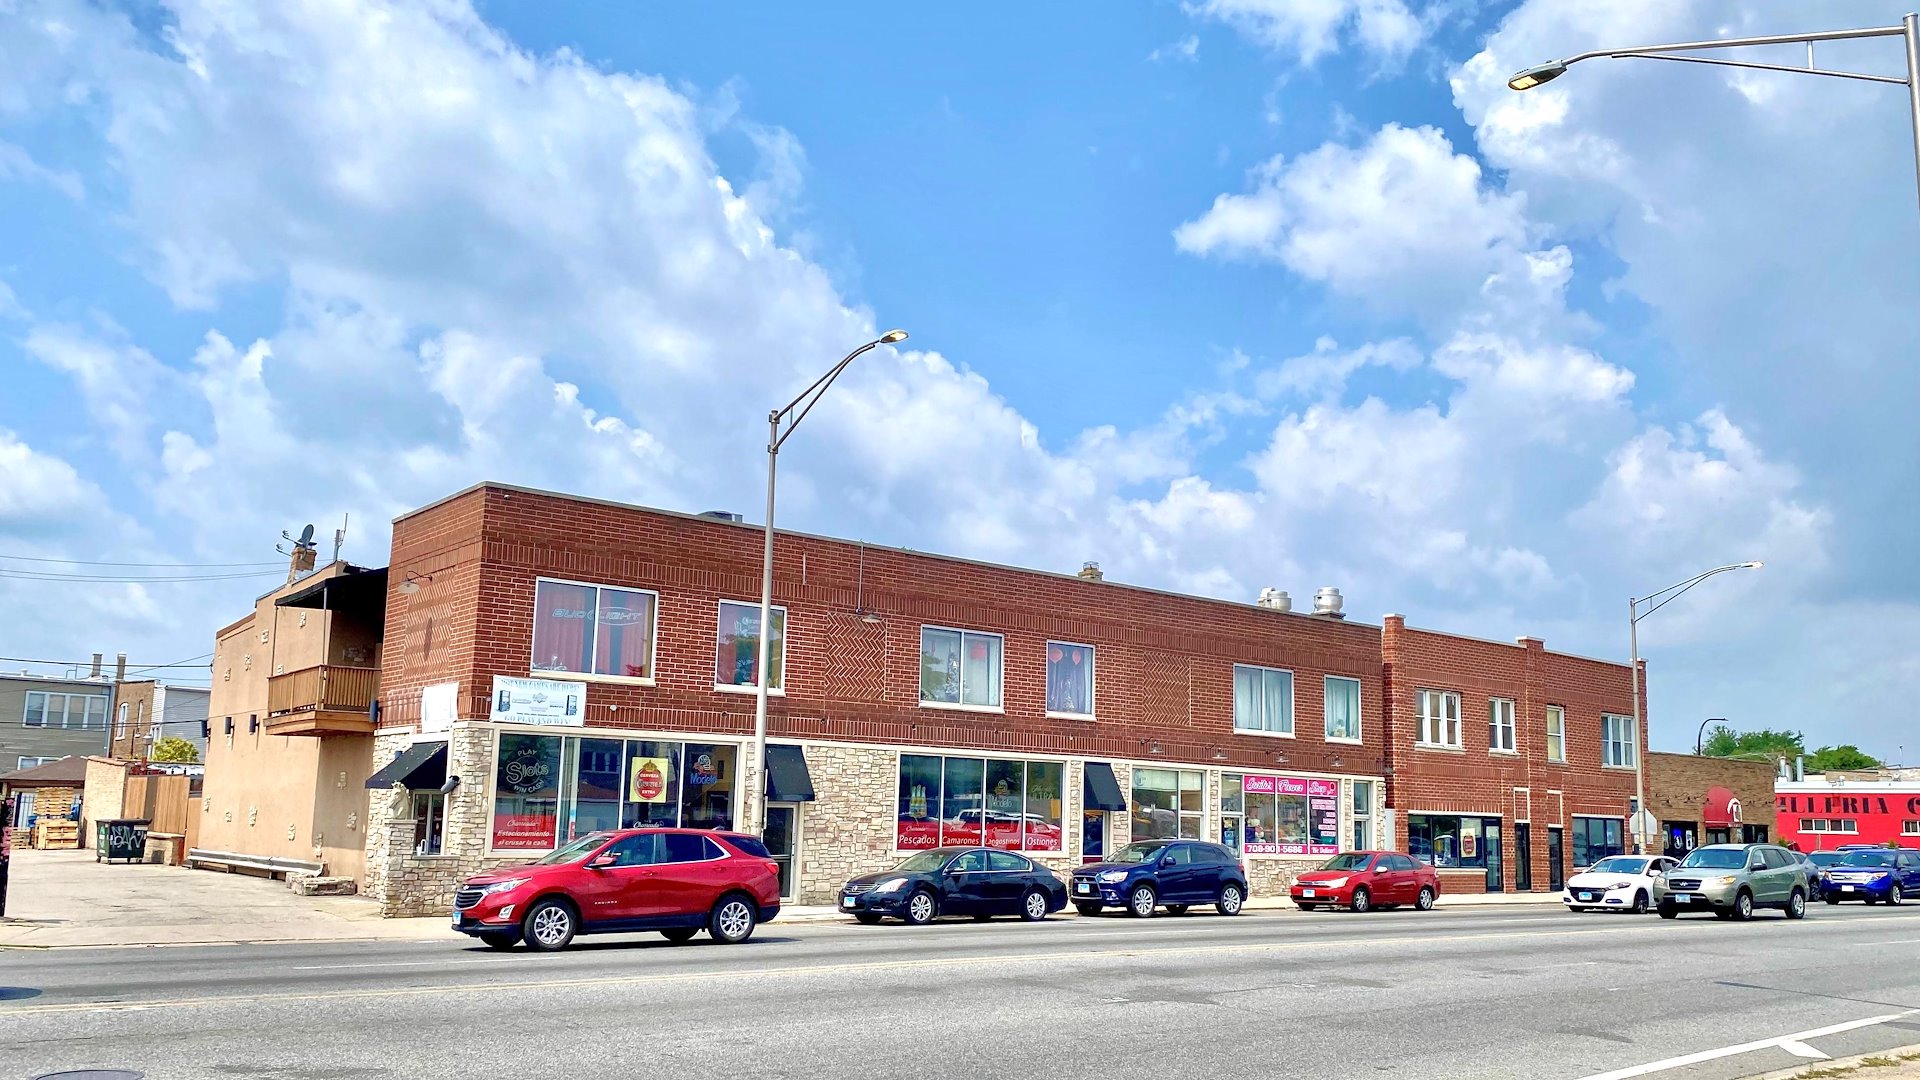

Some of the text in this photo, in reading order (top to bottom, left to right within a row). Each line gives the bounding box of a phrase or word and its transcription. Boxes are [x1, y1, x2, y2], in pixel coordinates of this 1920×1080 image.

[552, 608, 642, 620] BUD LIGHT
[518, 715, 534, 723] PLAY
[506, 761, 549, 784] Slots
[690, 773, 717, 785] Modelo
[514, 780, 544, 793] WIN CASH
[898, 834, 936, 844] Pescados
[942, 836, 979, 845] Camarones
[985, 837, 1020, 847] Langostinos
[1027, 836, 1058, 846] Ostiones
